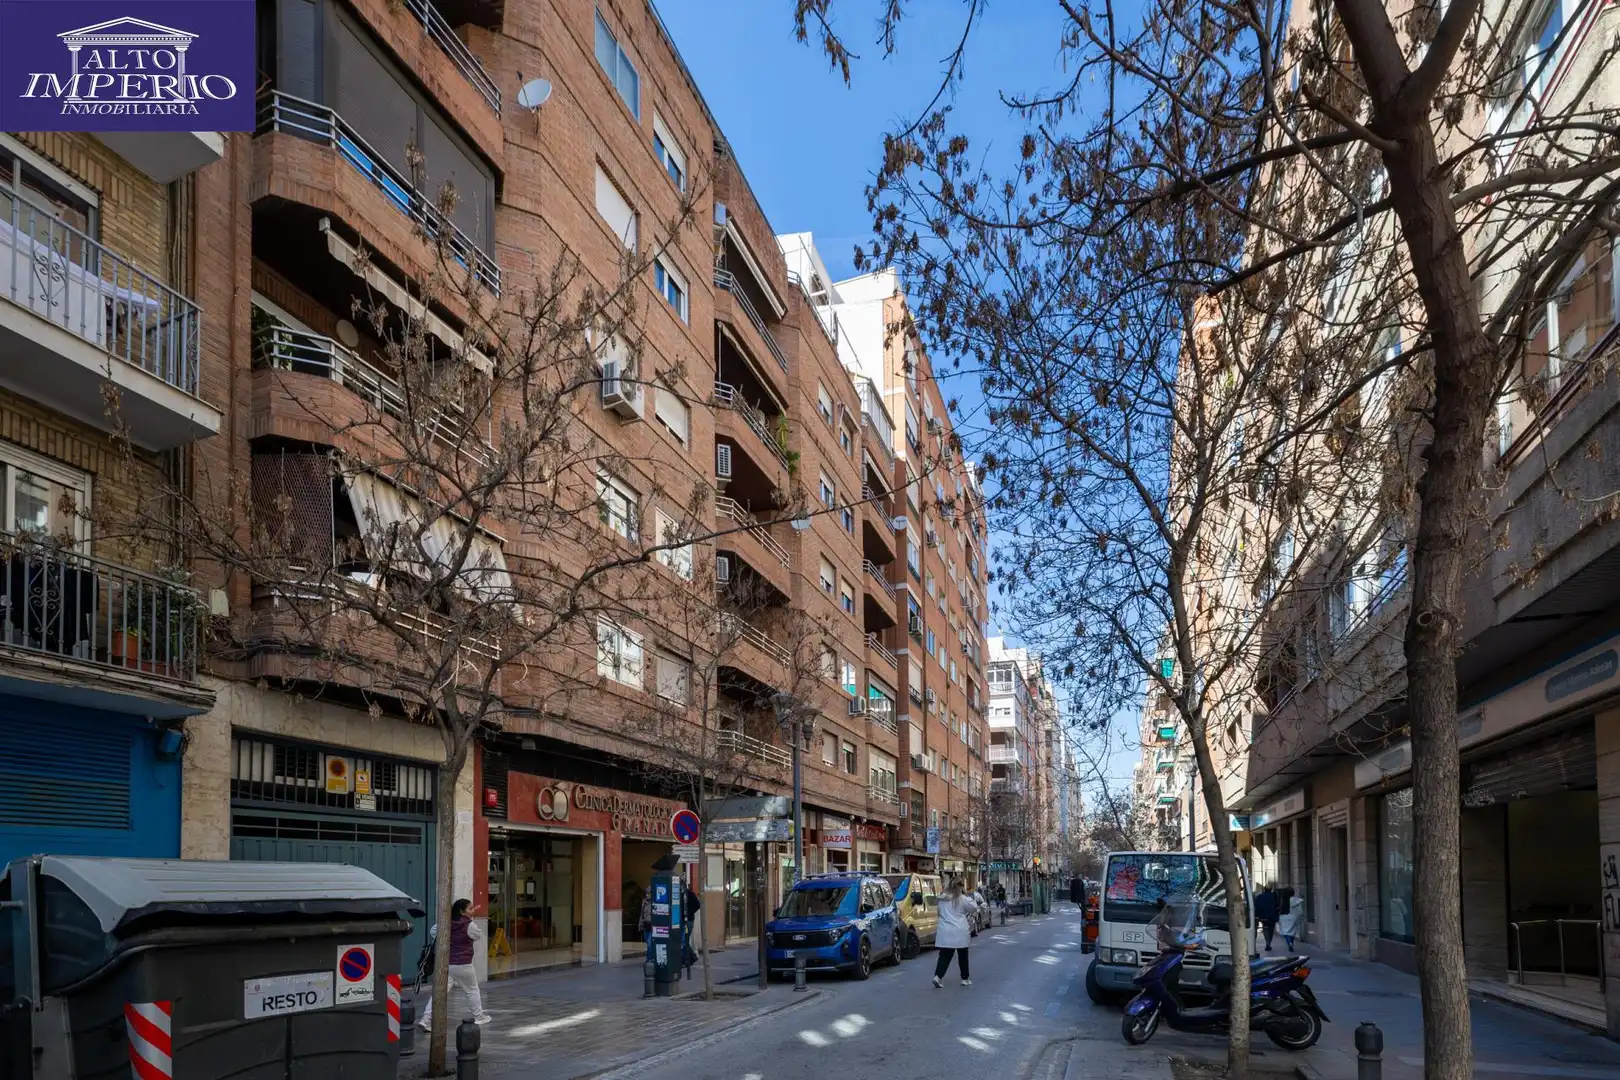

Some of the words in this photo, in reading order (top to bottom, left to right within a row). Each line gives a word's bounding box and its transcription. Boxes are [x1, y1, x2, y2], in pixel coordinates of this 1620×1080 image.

[612, 813, 671, 835] GRANAD
[823, 835, 852, 843] BAZAR
[262, 991, 317, 1012] RESTO
